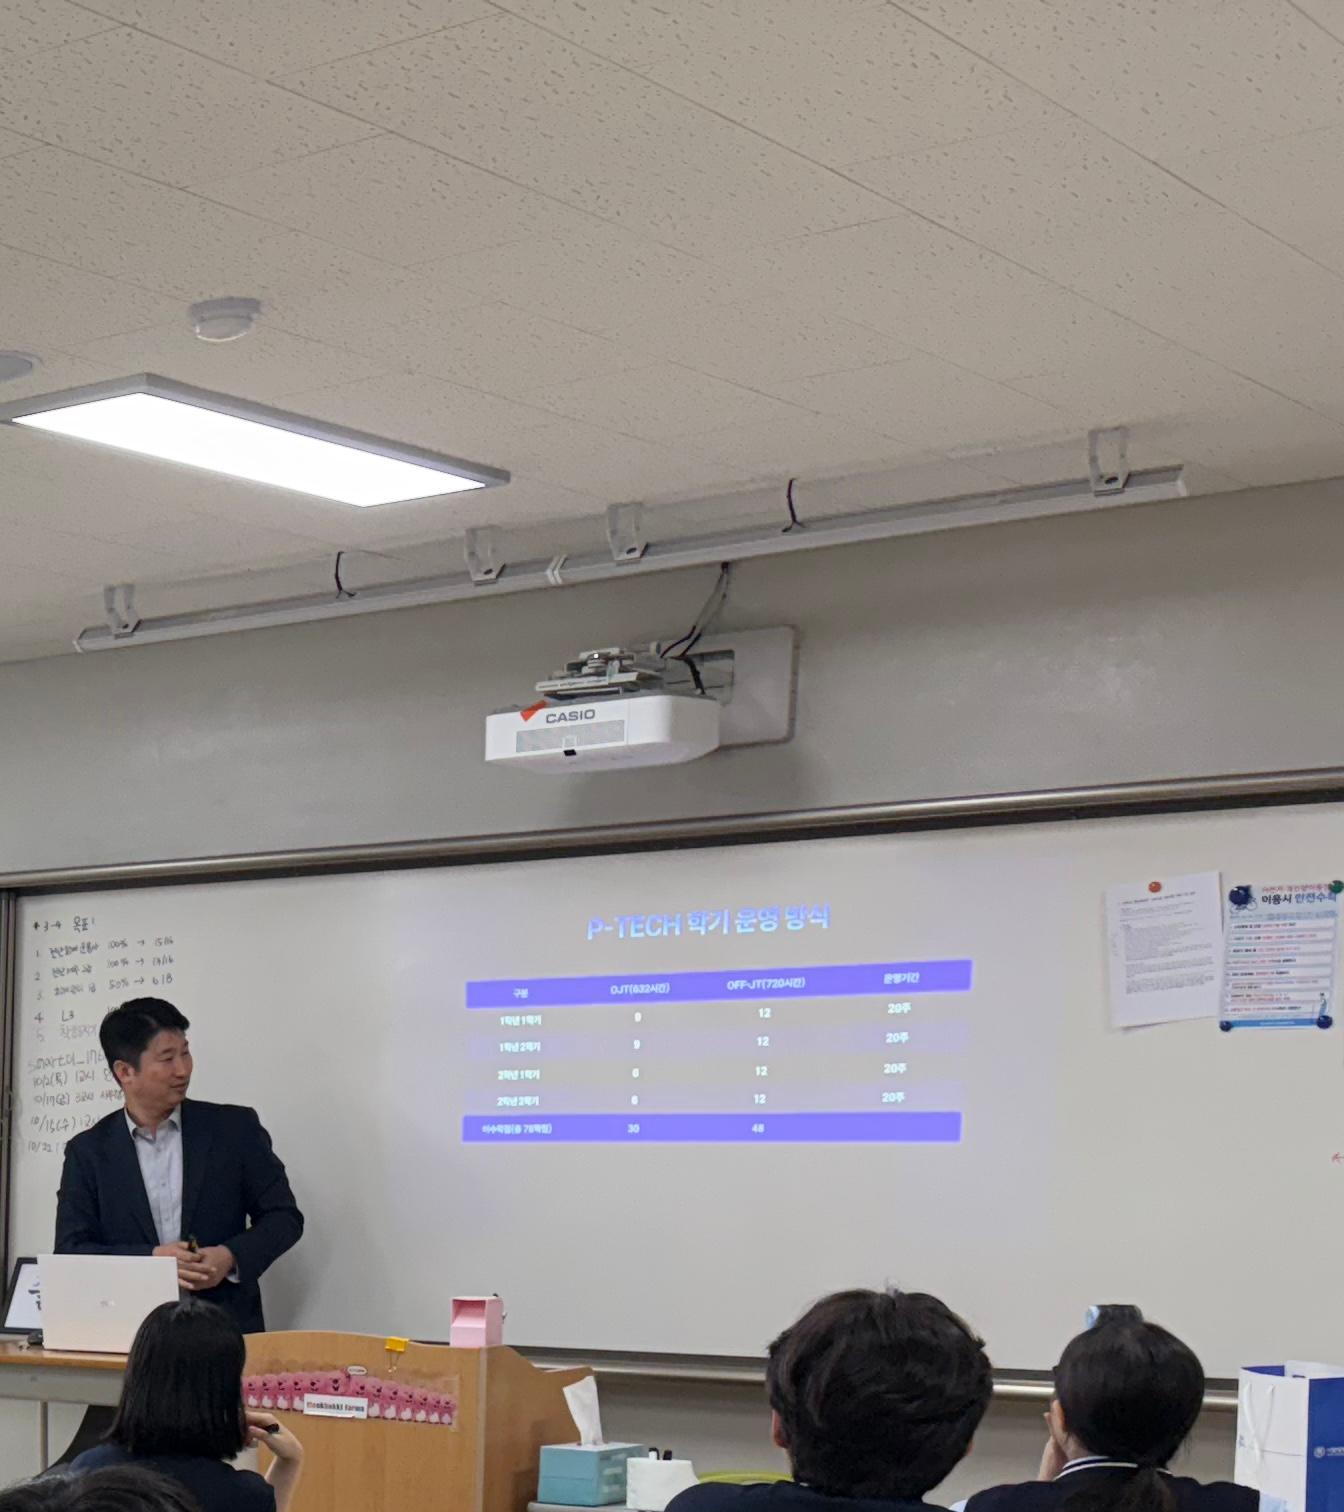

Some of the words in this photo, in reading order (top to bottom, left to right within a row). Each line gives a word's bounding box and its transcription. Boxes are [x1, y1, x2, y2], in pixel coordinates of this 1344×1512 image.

[545, 709, 596, 724] CASIO
[586, 913, 682, 941] P-TECH
[687, 908, 730, 936] 학기
[735, 905, 780, 933] 운영
[783, 902, 831, 931] 방식
[758, 1008, 771, 1019] 12
[757, 1036, 770, 1047] 12
[755, 1065, 768, 1076] 12
[754, 1094, 766, 1104] 12
